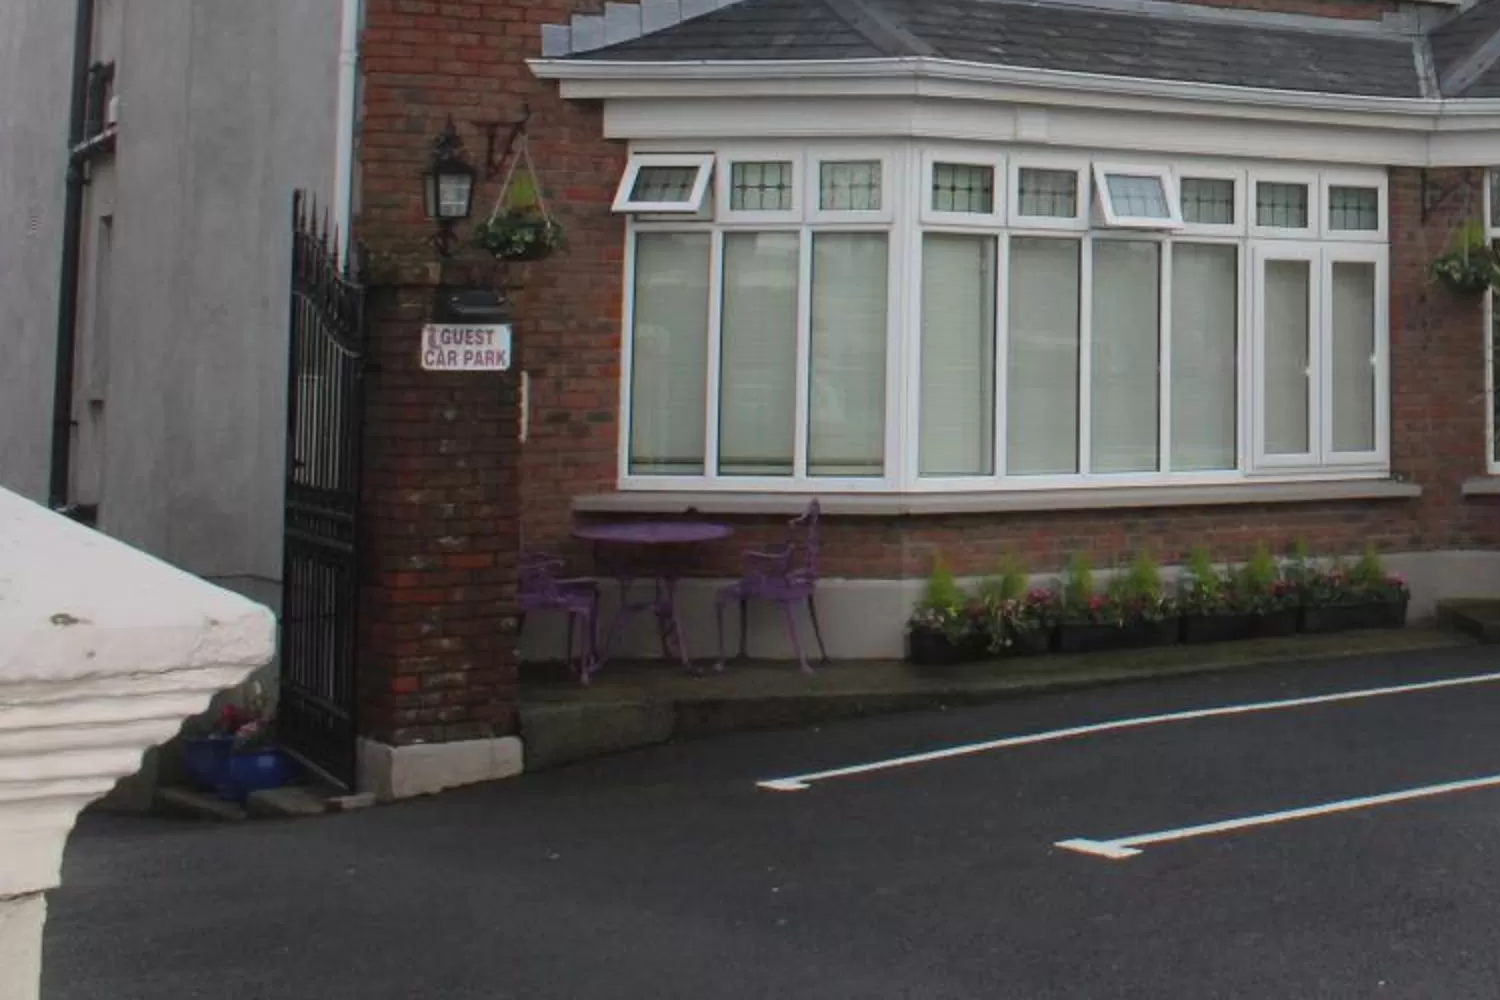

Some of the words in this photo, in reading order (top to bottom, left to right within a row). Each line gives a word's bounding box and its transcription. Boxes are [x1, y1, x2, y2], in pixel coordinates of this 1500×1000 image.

[441, 328, 494, 345] GUEST
[425, 349, 457, 366] CAR
[464, 349, 506, 366] PARK
